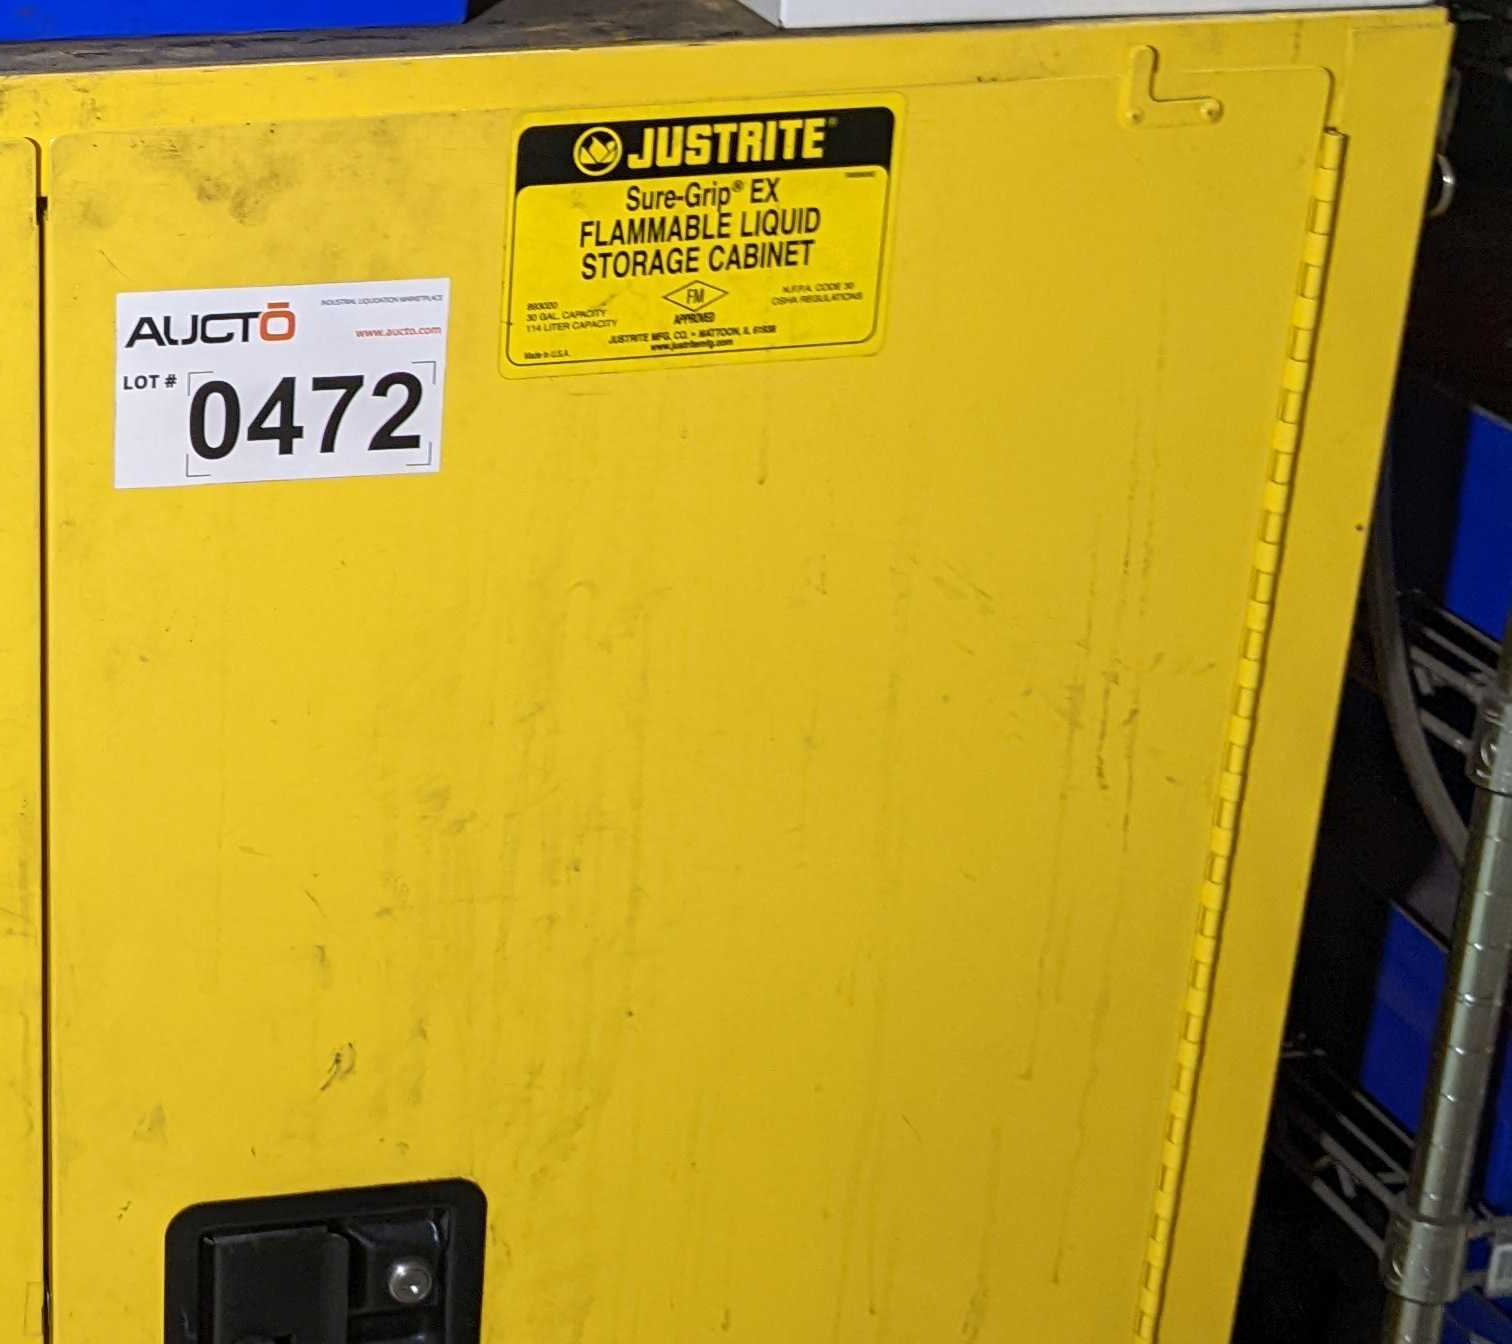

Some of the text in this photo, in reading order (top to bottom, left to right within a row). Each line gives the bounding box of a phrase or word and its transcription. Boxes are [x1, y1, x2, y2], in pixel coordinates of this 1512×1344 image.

[750, 178, 780, 204] EX
[580, 207, 821, 248] FLAMMABLE LIQUID
[581, 239, 815, 280] STORAGE CABINET
[799, 291, 864, 303] REGULATIONS
[562, 309, 608, 319] CAPACITY
[673, 311, 716, 325] APPROVED
[355, 326, 442, 337] www.aucto.com
[543, 322, 570, 331] LITER
[572, 319, 618, 330] CAPACITY
[608, 333, 649, 344] JUSTRITE
[123, 374, 178, 390] LOT #
[189, 371, 423, 460] 0472
